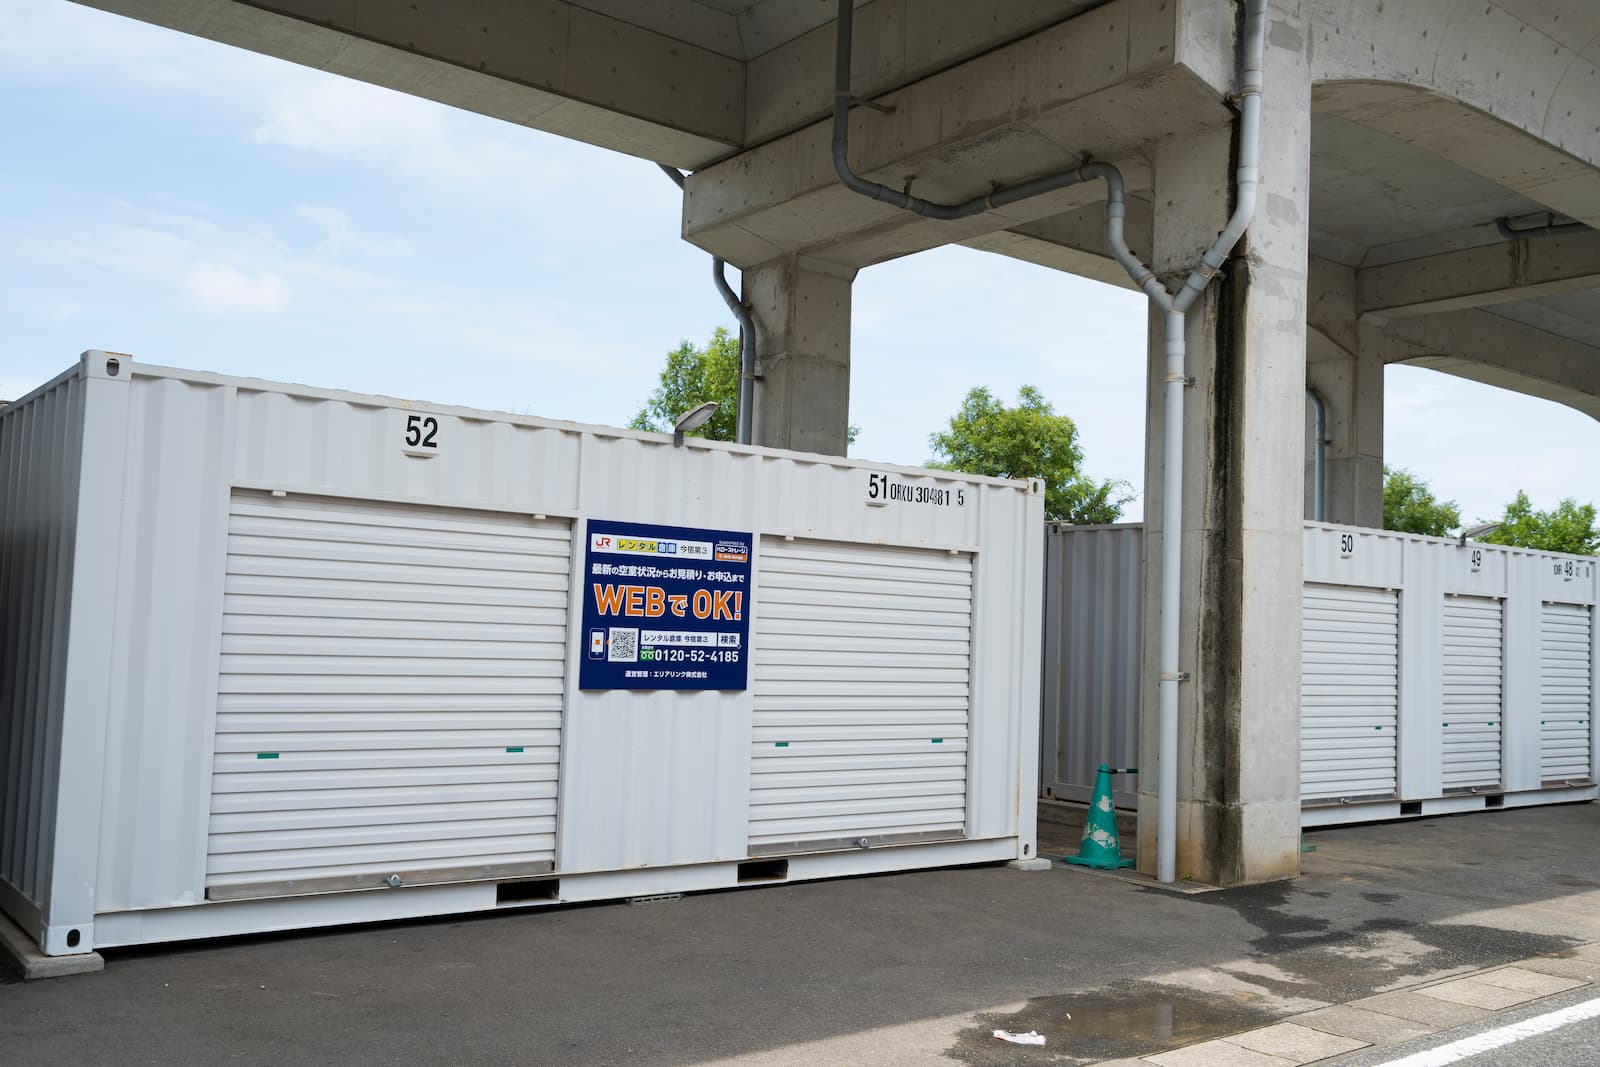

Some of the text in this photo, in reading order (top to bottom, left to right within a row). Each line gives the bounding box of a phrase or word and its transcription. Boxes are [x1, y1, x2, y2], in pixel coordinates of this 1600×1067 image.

[405, 415, 438, 448] 52
[868, 473, 887, 500] 51
[958, 490, 964, 505] 5
[596, 537, 611, 548] JR
[618, 540, 676, 553] レンタル倉庫
[1341, 534, 1353, 553] 50
[1471, 550, 1481, 567] 49
[1564, 560, 1573, 576] 48
[720, 634, 737, 645] 検索
[654, 649, 739, 662] 0120-52-4185
